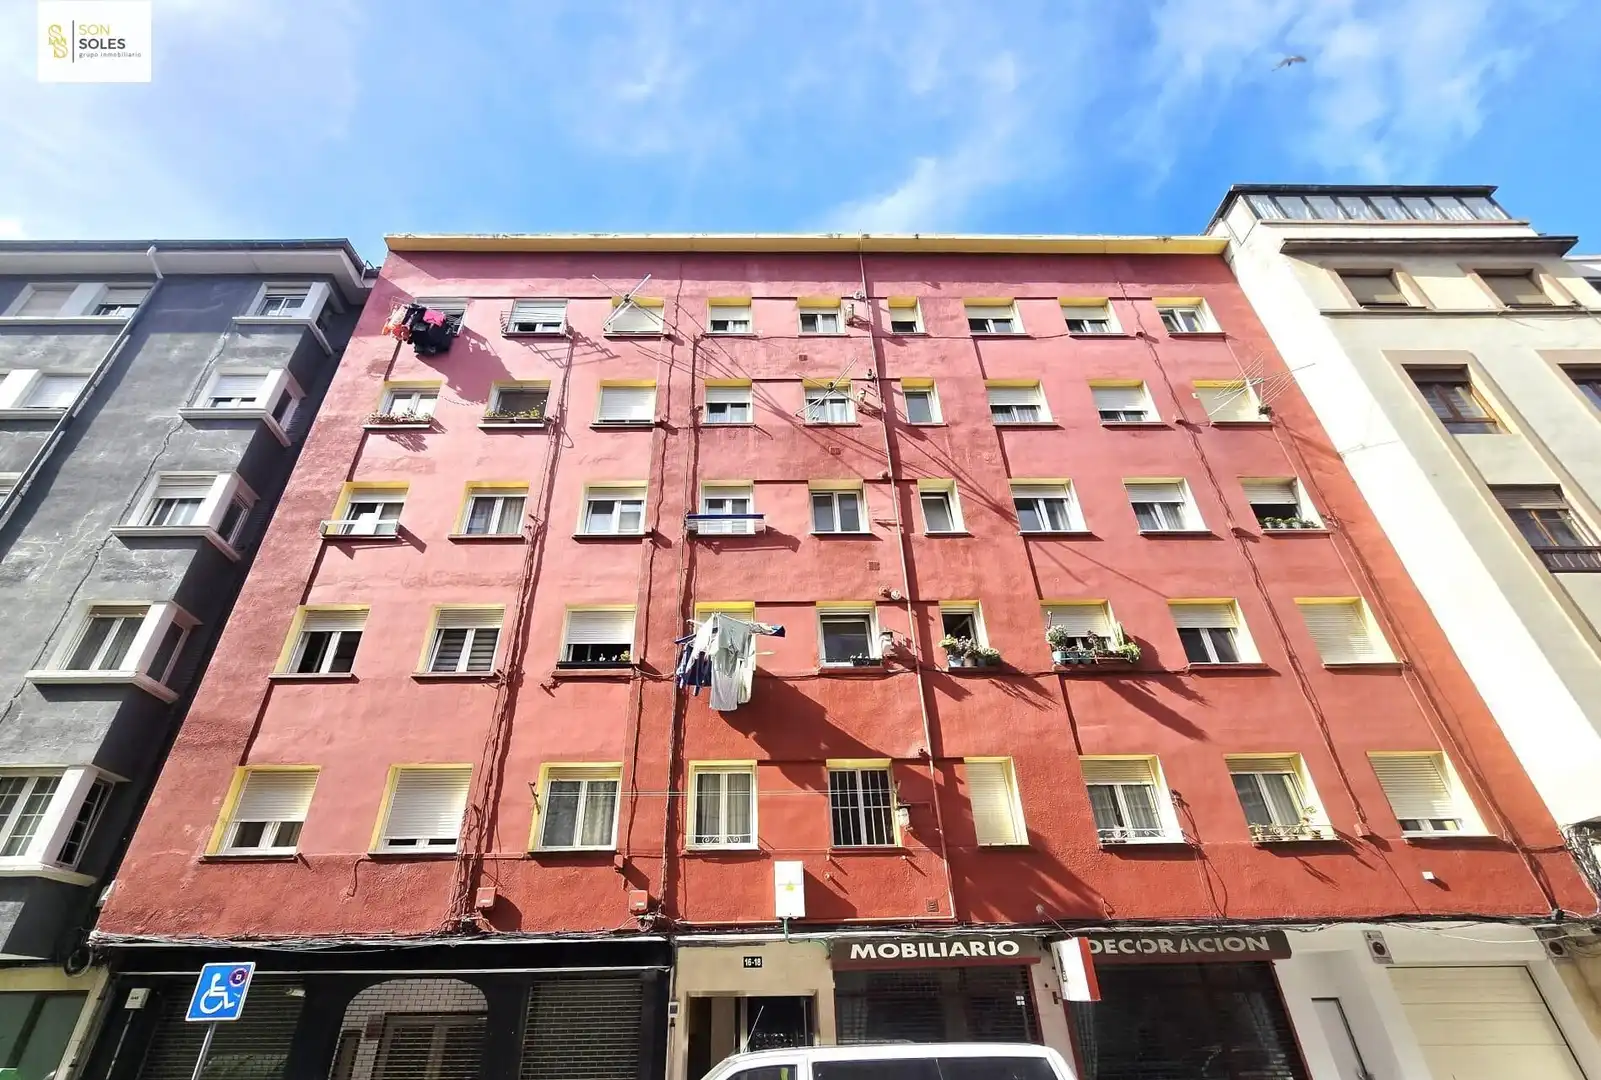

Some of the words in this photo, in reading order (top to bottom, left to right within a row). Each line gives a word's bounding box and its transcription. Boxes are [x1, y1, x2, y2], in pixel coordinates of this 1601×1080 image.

[850, 940, 1020, 959] MOBILIARIO
[1088, 936, 1270, 954] DECORACION
[745, 957, 761, 966] 16-18
